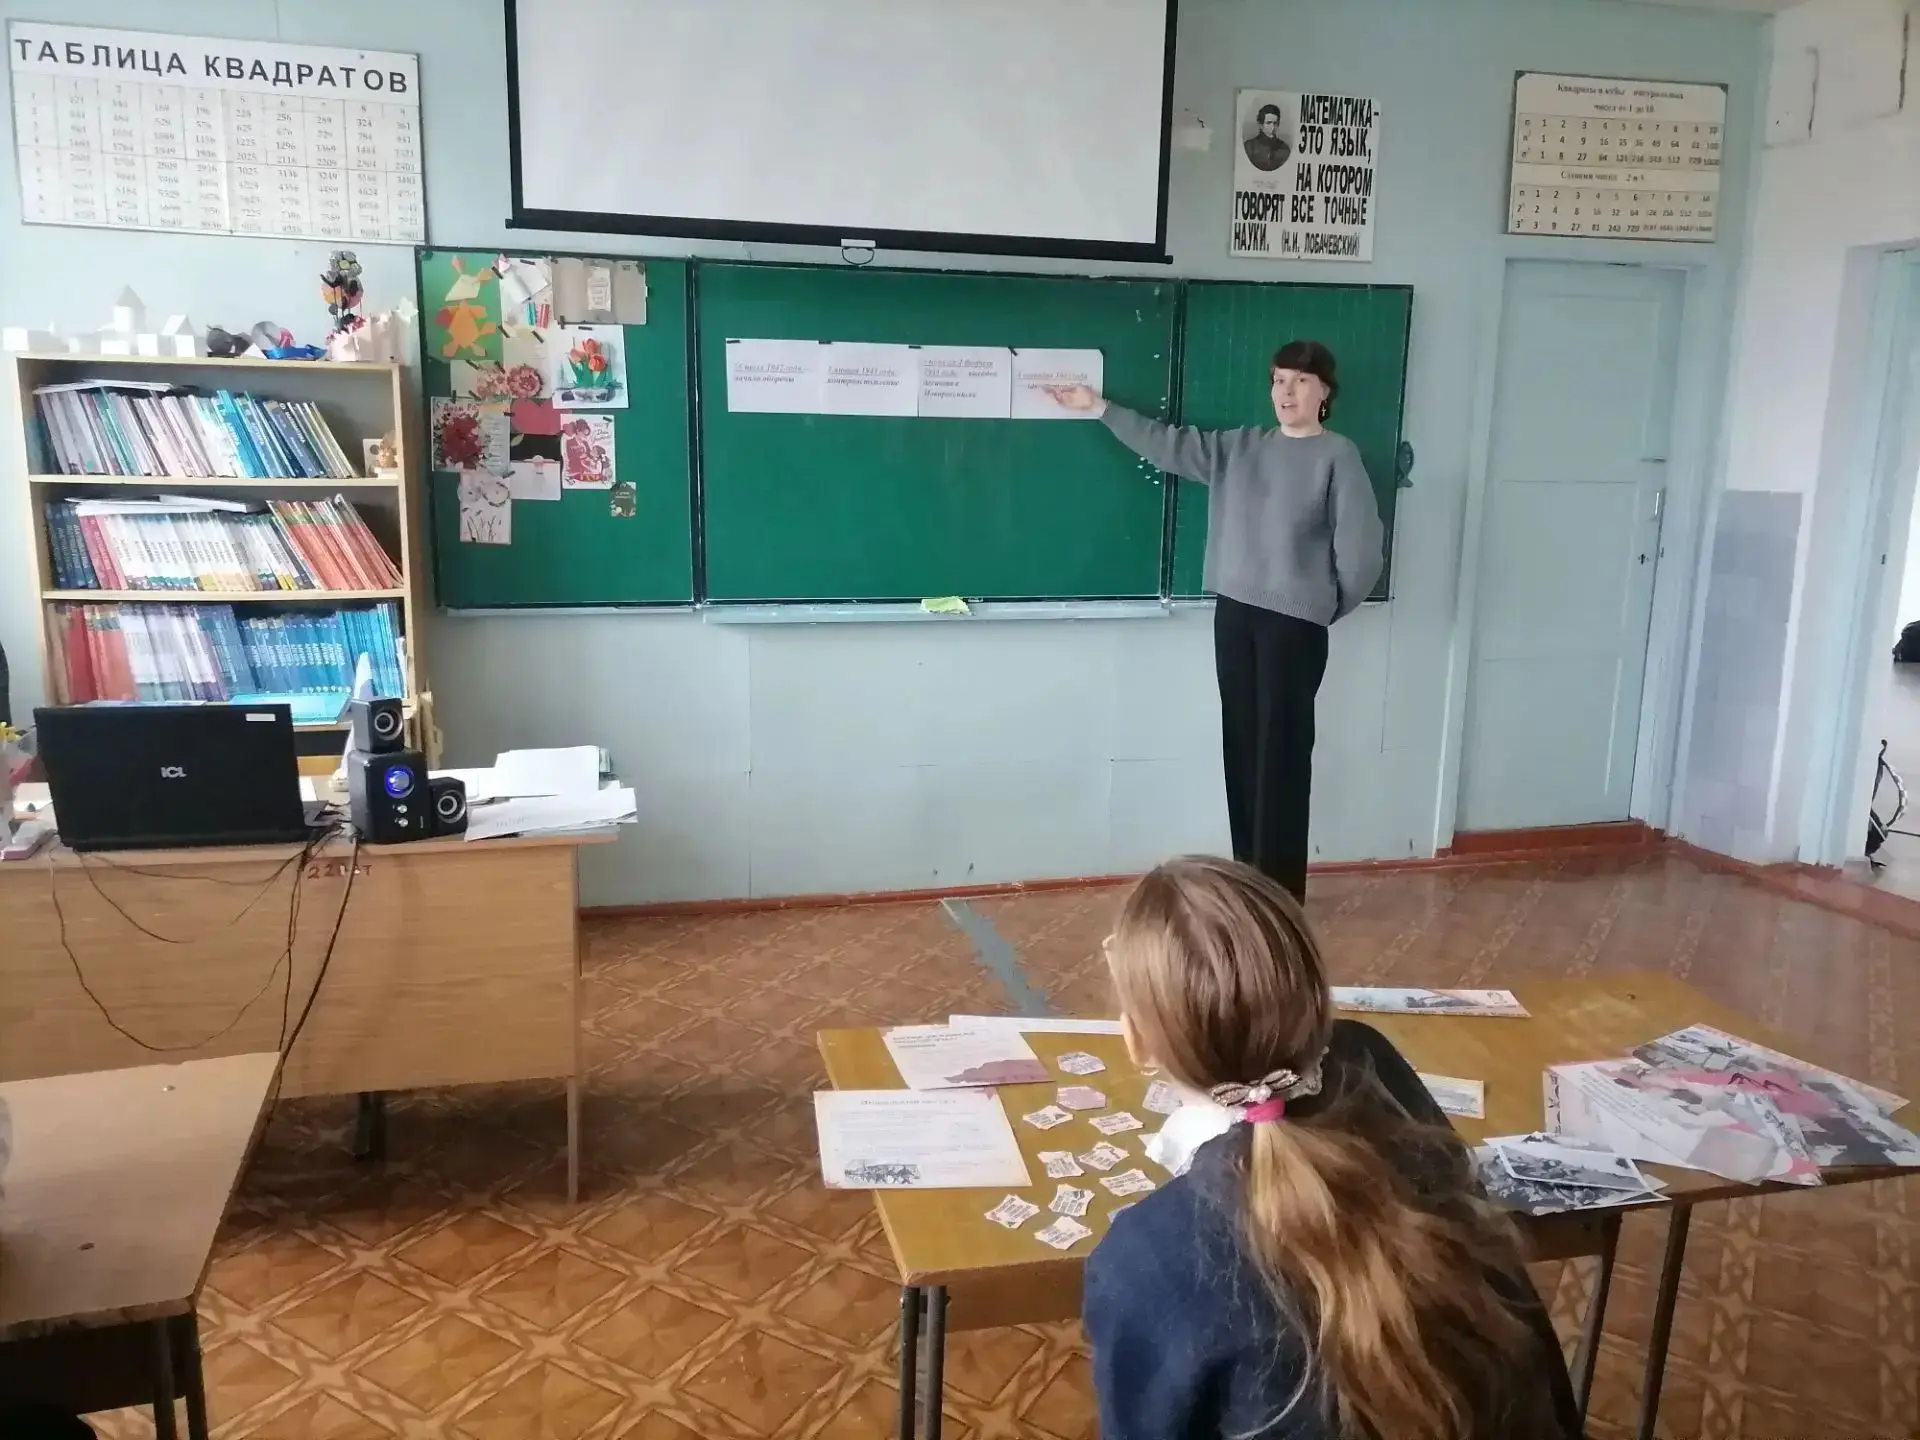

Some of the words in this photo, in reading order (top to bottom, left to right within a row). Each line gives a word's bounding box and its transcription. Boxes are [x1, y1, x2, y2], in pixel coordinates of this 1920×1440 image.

[15, 38, 187, 76] ТАБЛИЦА
[204, 54, 408, 93] КВАДРАТОВ
[1299, 124, 1324, 155] ЭТО
[1330, 127, 1372, 164] ЯЗЫК,
[1576, 152, 1587, 161] 27
[1599, 136, 1610, 146] 16
[1670, 140, 1680, 149] 64
[1296, 163, 1312, 192] НА
[1316, 164, 1373, 197] КОТОРОМ
[1234, 191, 1285, 223] ГОВОРЯТ
[1291, 194, 1315, 223] ВСЕ
[1324, 196, 1367, 226] ТОЧНЫЕ
[1611, 208, 1621, 217] 32
[1234, 222, 1269, 253] НАУКИ.
[1570, 222, 1581, 232] 27
[1591, 223, 1601, 232] 81
